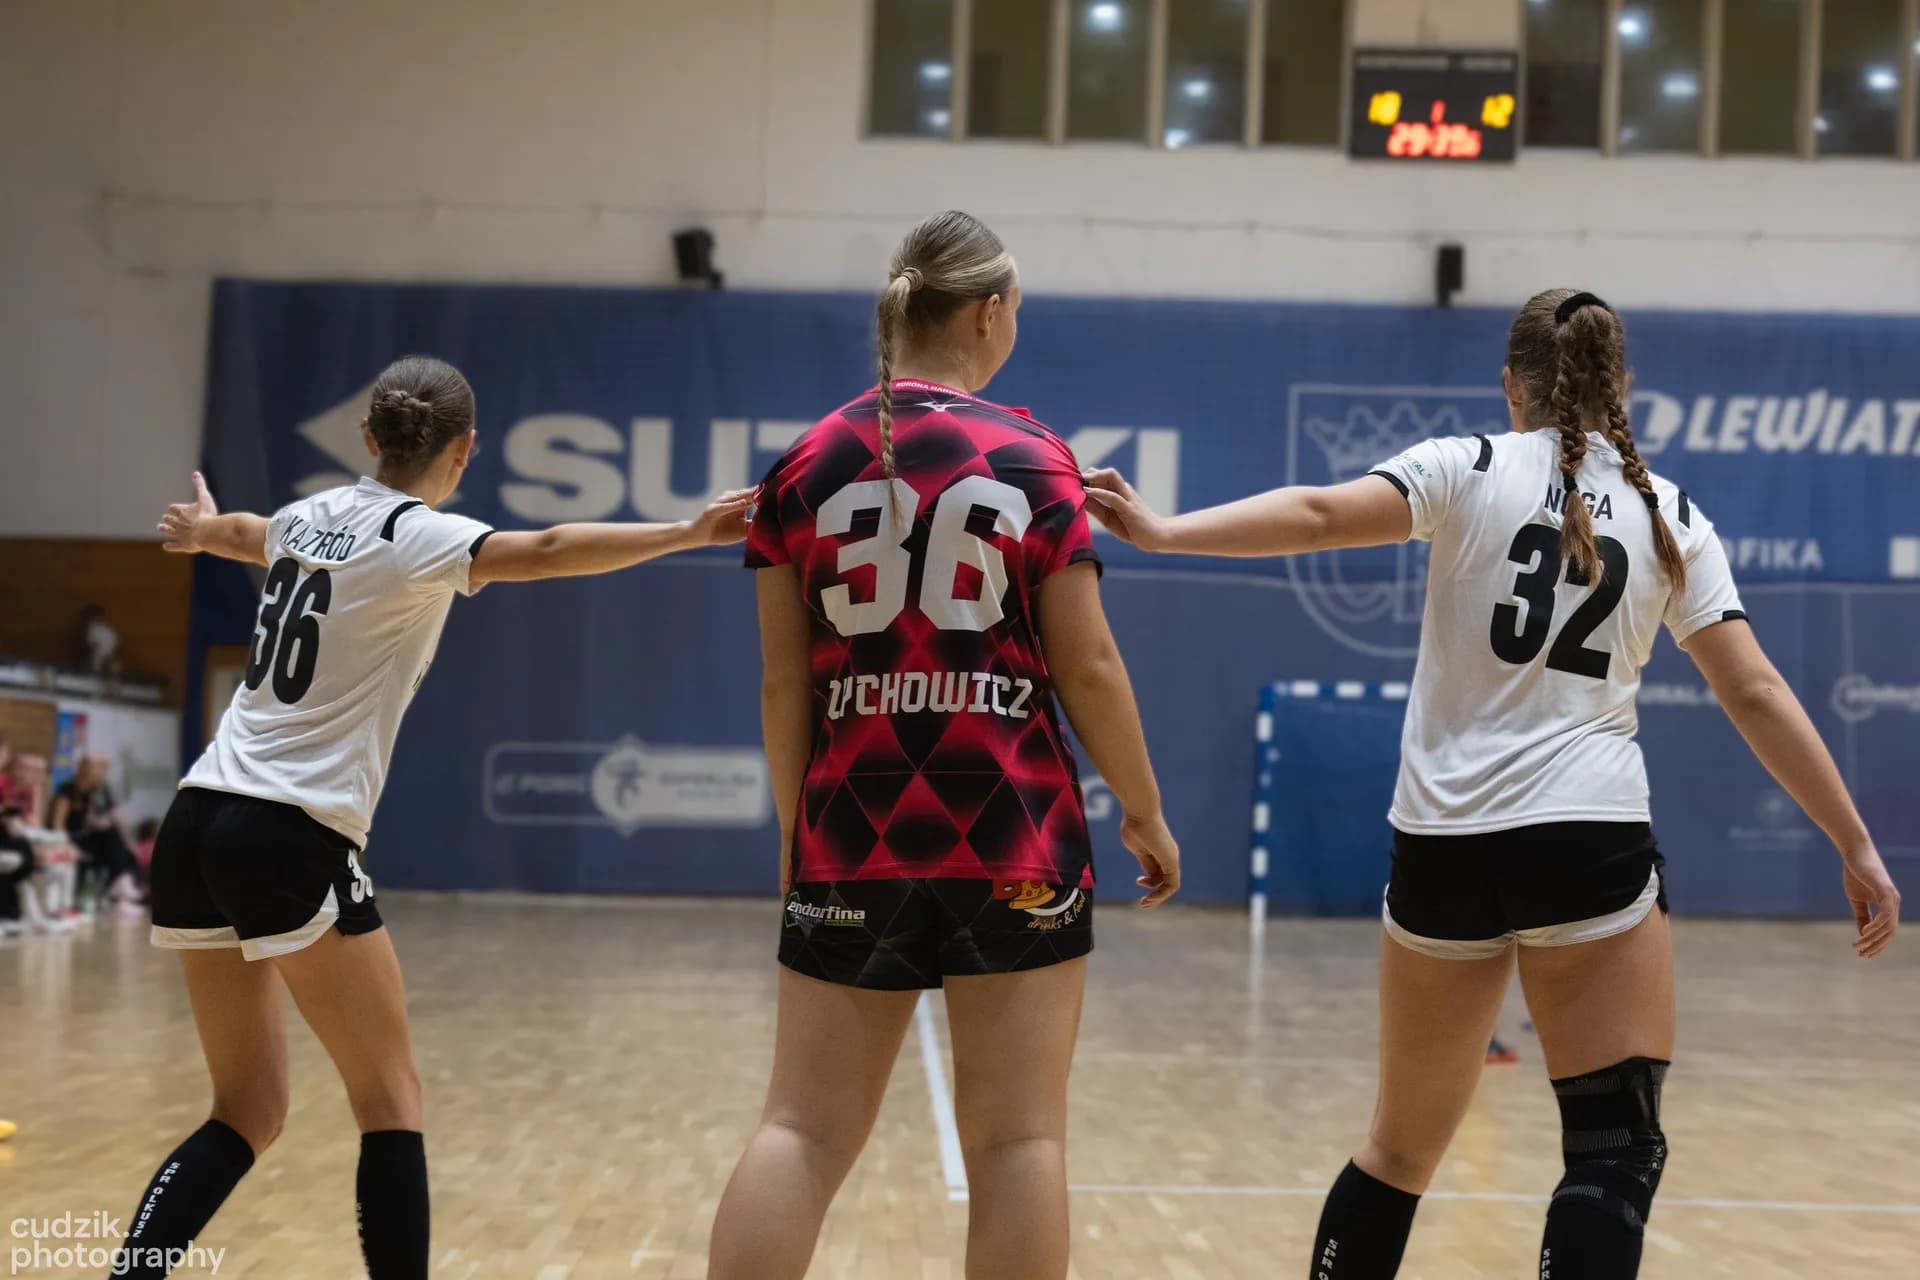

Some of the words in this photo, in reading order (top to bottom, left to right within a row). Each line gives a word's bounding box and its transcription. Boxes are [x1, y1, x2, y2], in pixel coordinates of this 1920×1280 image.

[1684, 388, 1920, 454] LEWIAT
[816, 475, 1033, 637] 36
[1490, 523, 1629, 680] 32
[245, 557, 332, 704] 36
[787, 901, 866, 920] endorfina
